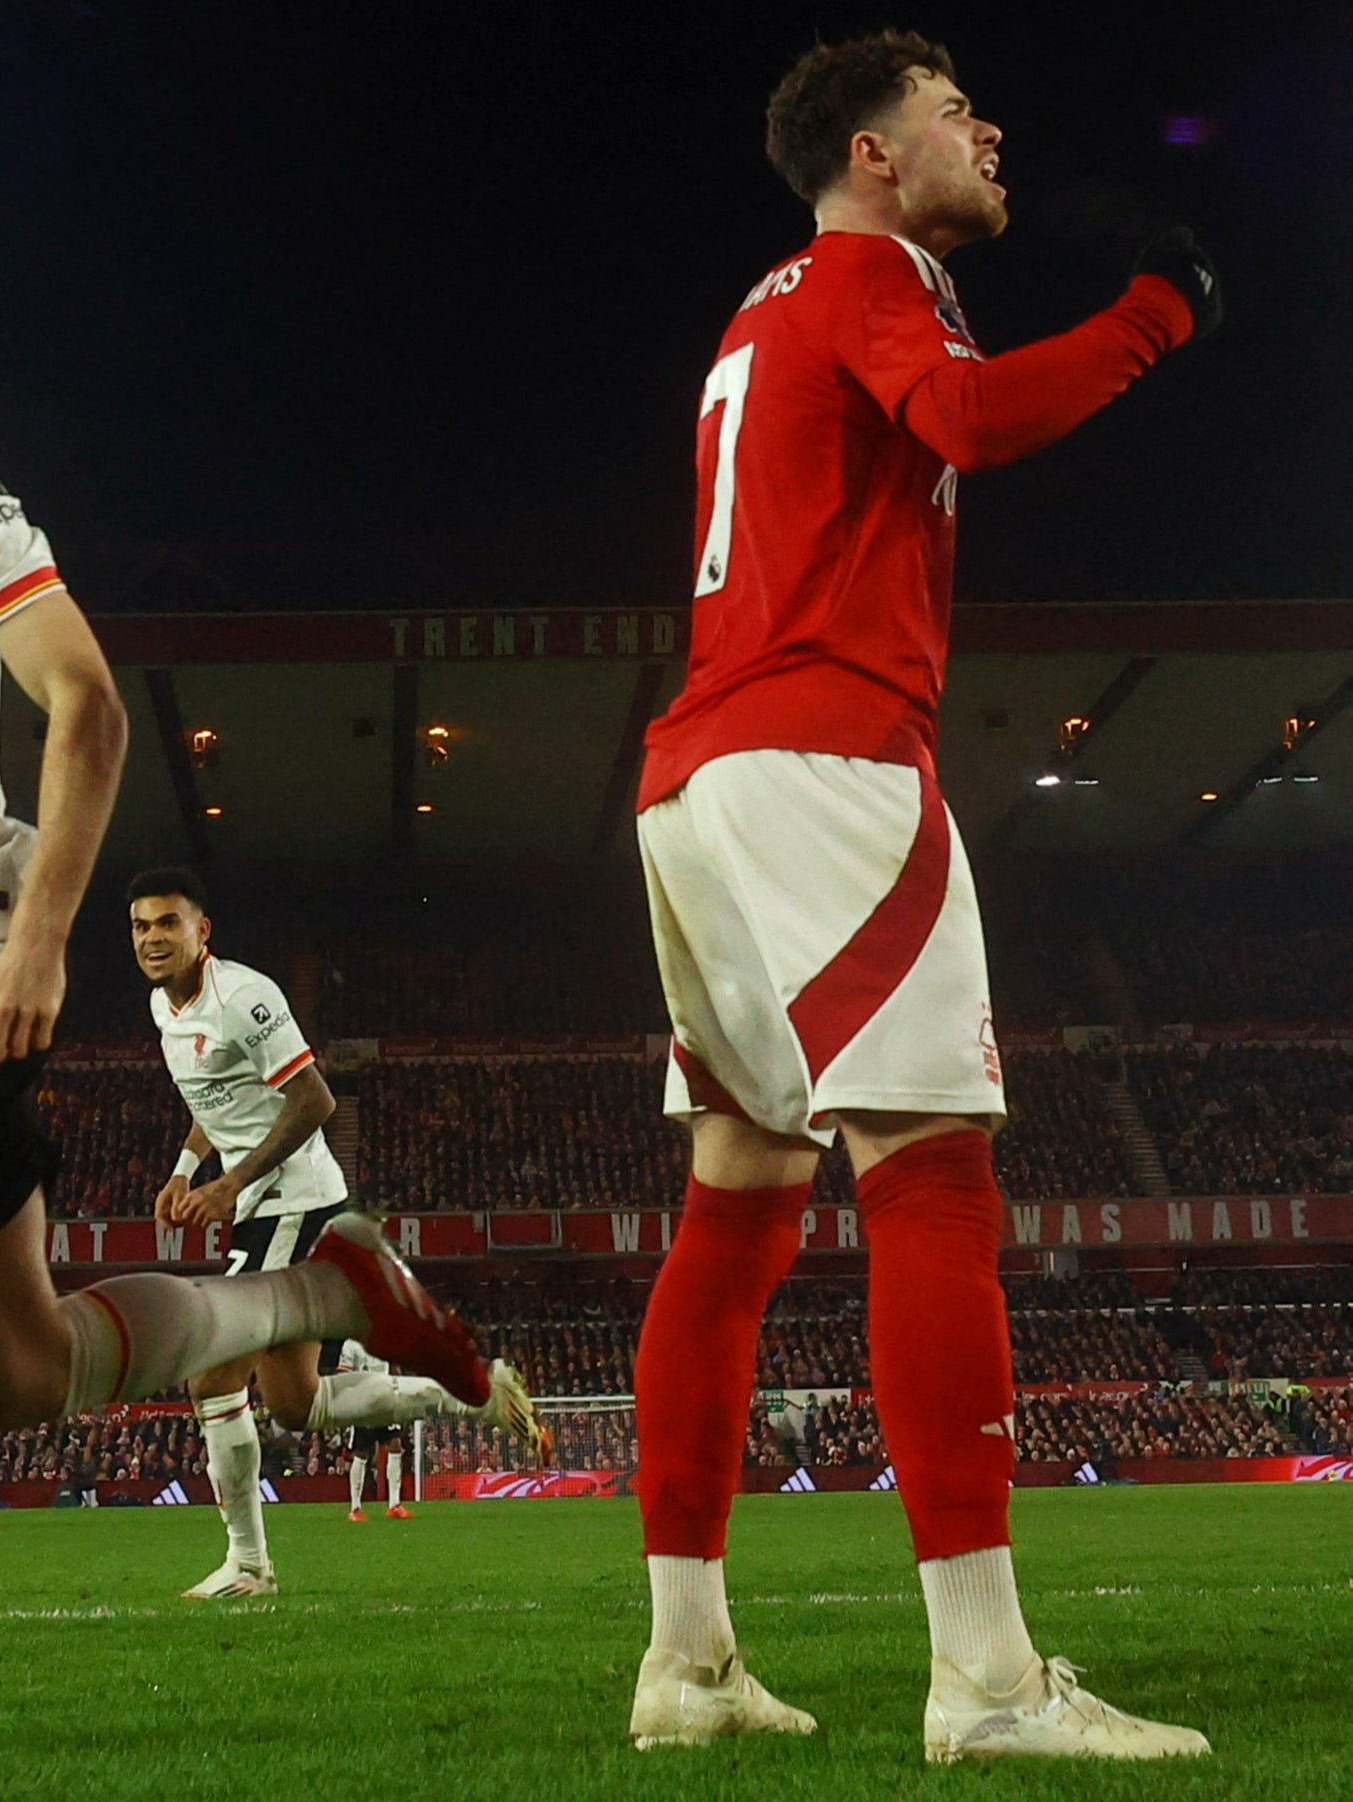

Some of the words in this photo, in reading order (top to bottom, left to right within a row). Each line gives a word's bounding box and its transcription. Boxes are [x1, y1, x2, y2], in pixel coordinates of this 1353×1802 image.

[694, 341, 754, 598] 7
[390, 615, 548, 657] TRENT
[583, 613, 676, 655] END
[245, 1011, 290, 1049] Expedia
[155, 1219, 223, 1262] WE
[1012, 1203, 1122, 1245] WAS
[1167, 1199, 1310, 1242] MADE
